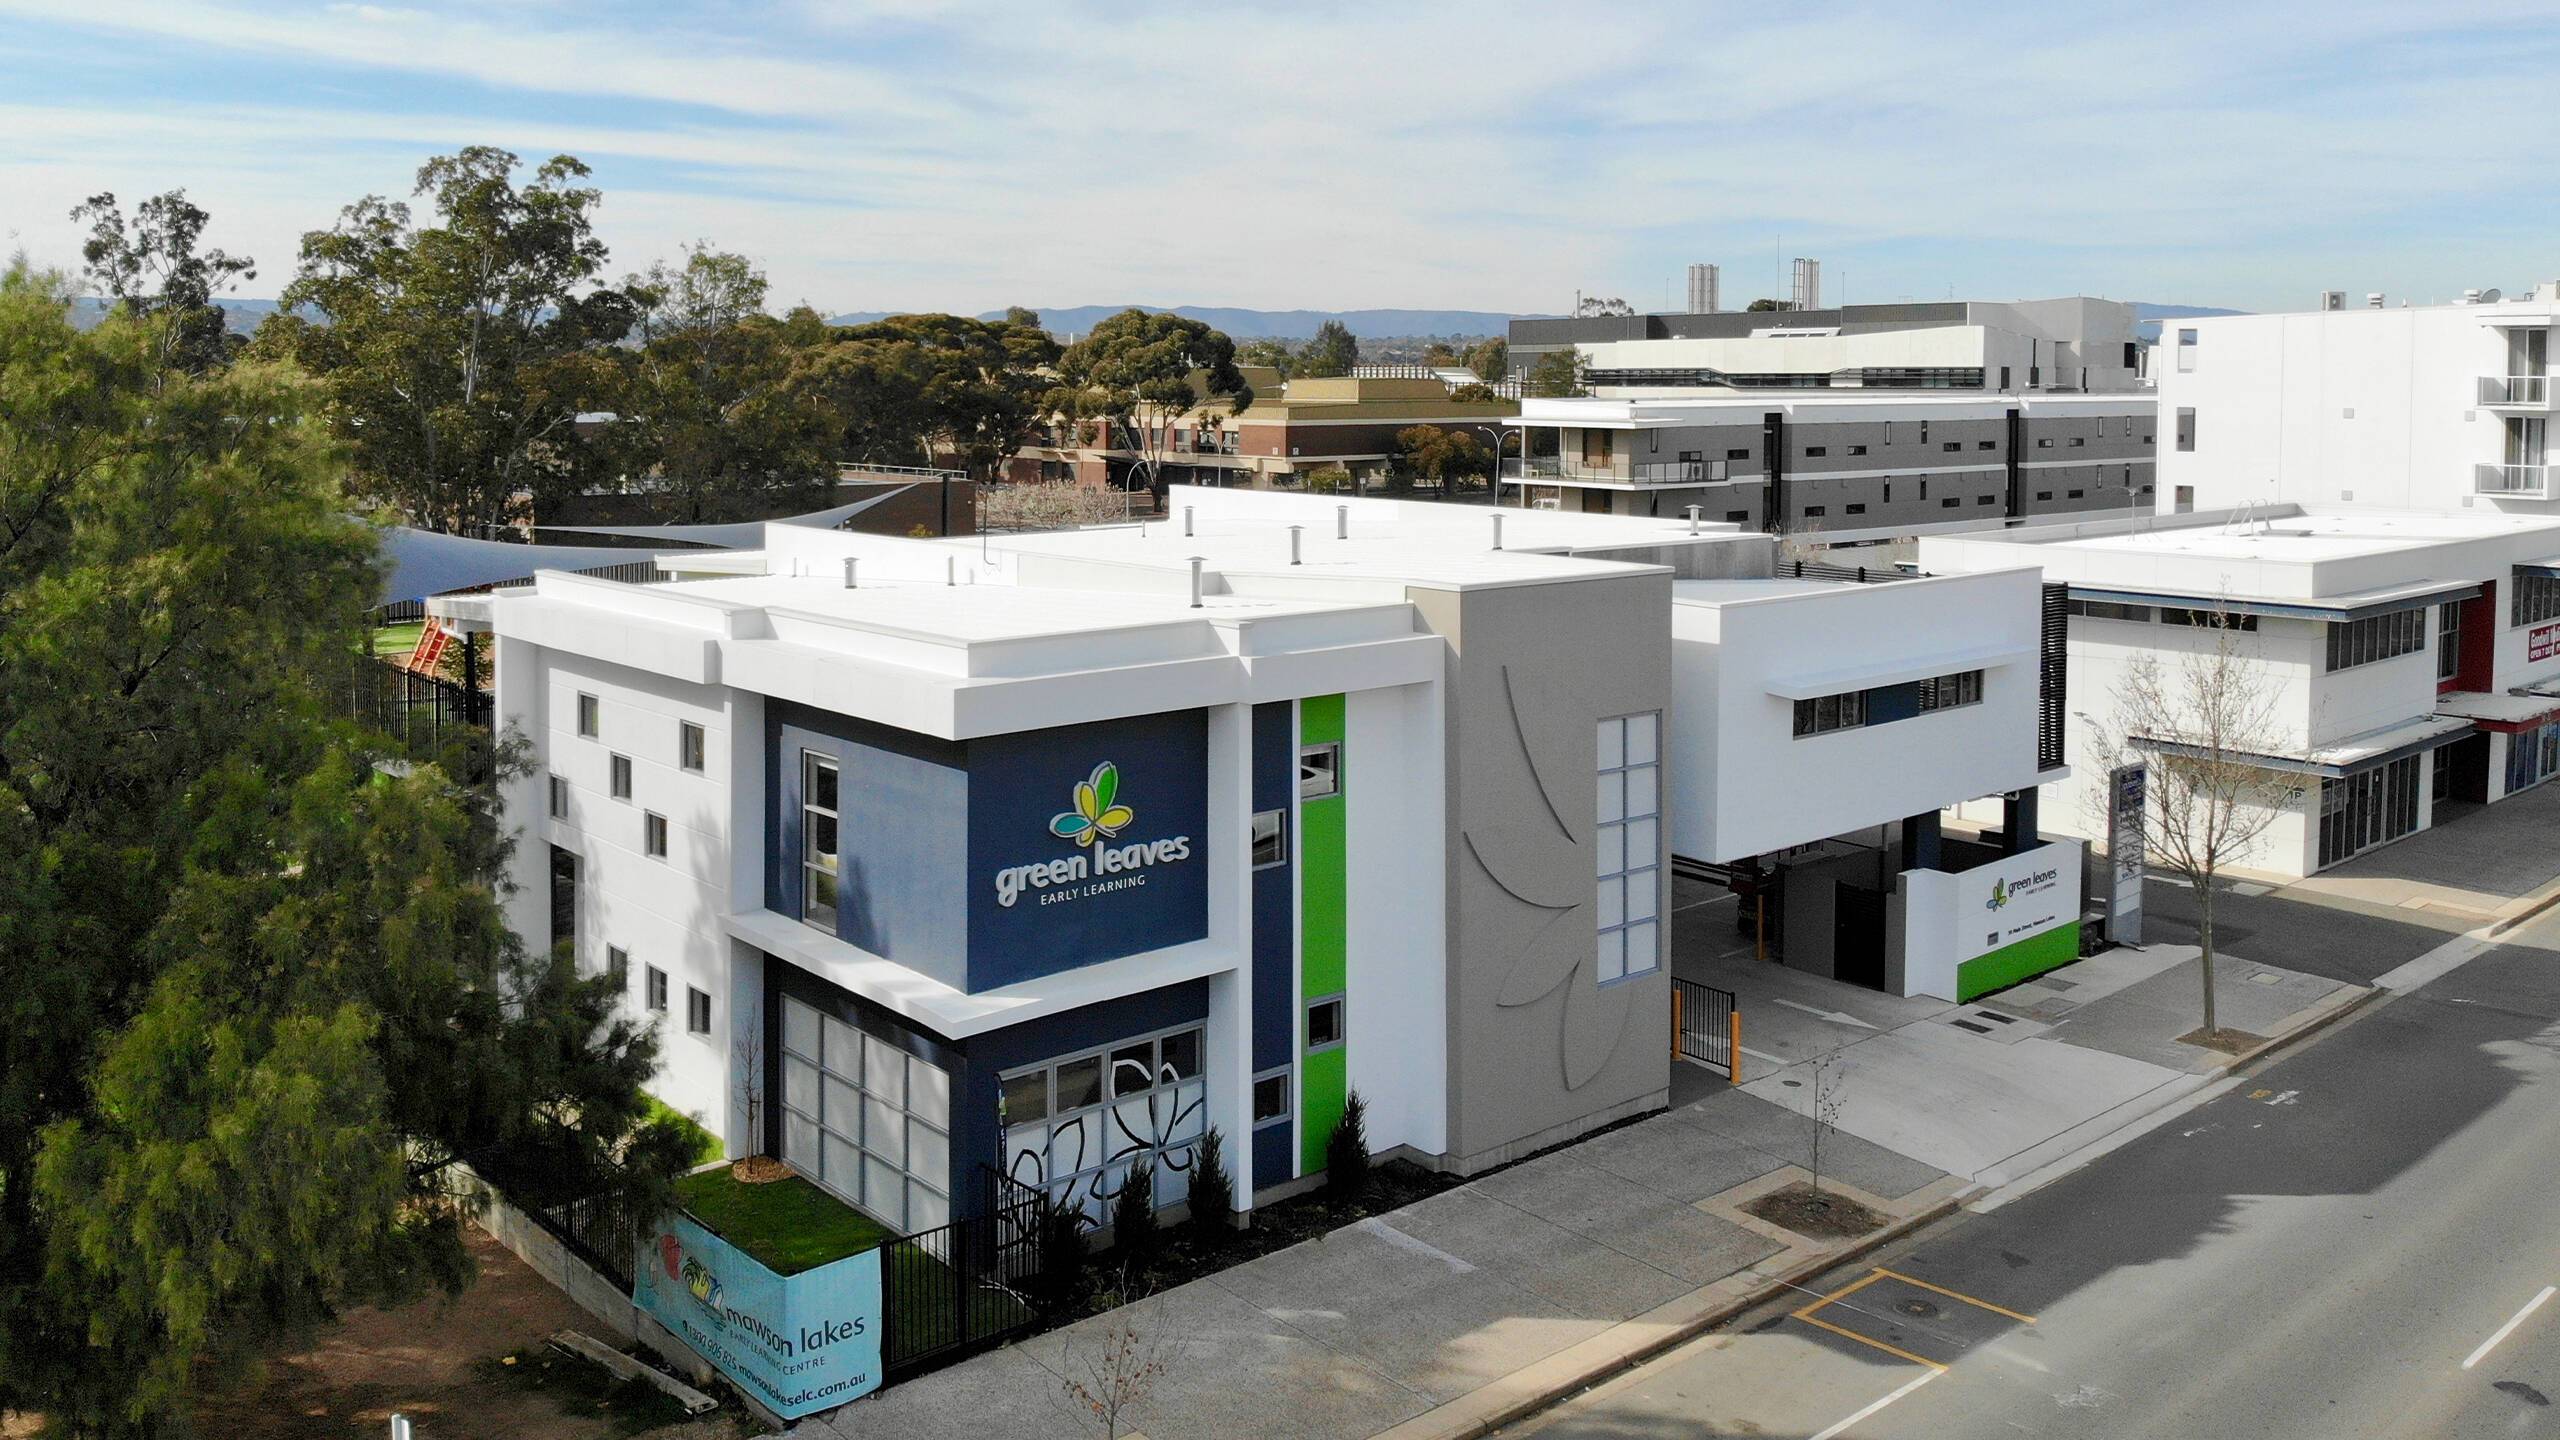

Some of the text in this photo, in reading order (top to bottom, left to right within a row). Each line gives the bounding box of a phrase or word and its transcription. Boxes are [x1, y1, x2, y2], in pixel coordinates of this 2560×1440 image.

[995, 835, 1190, 907] green leaves
[2008, 868, 2057, 898] green leaves
[1040, 875, 1146, 905] EARLY LEARNING
[726, 1306, 865, 1357] mawson lakes
[722, 1350, 737, 1370] 825
[782, 1355, 826, 1376] CENTRE
